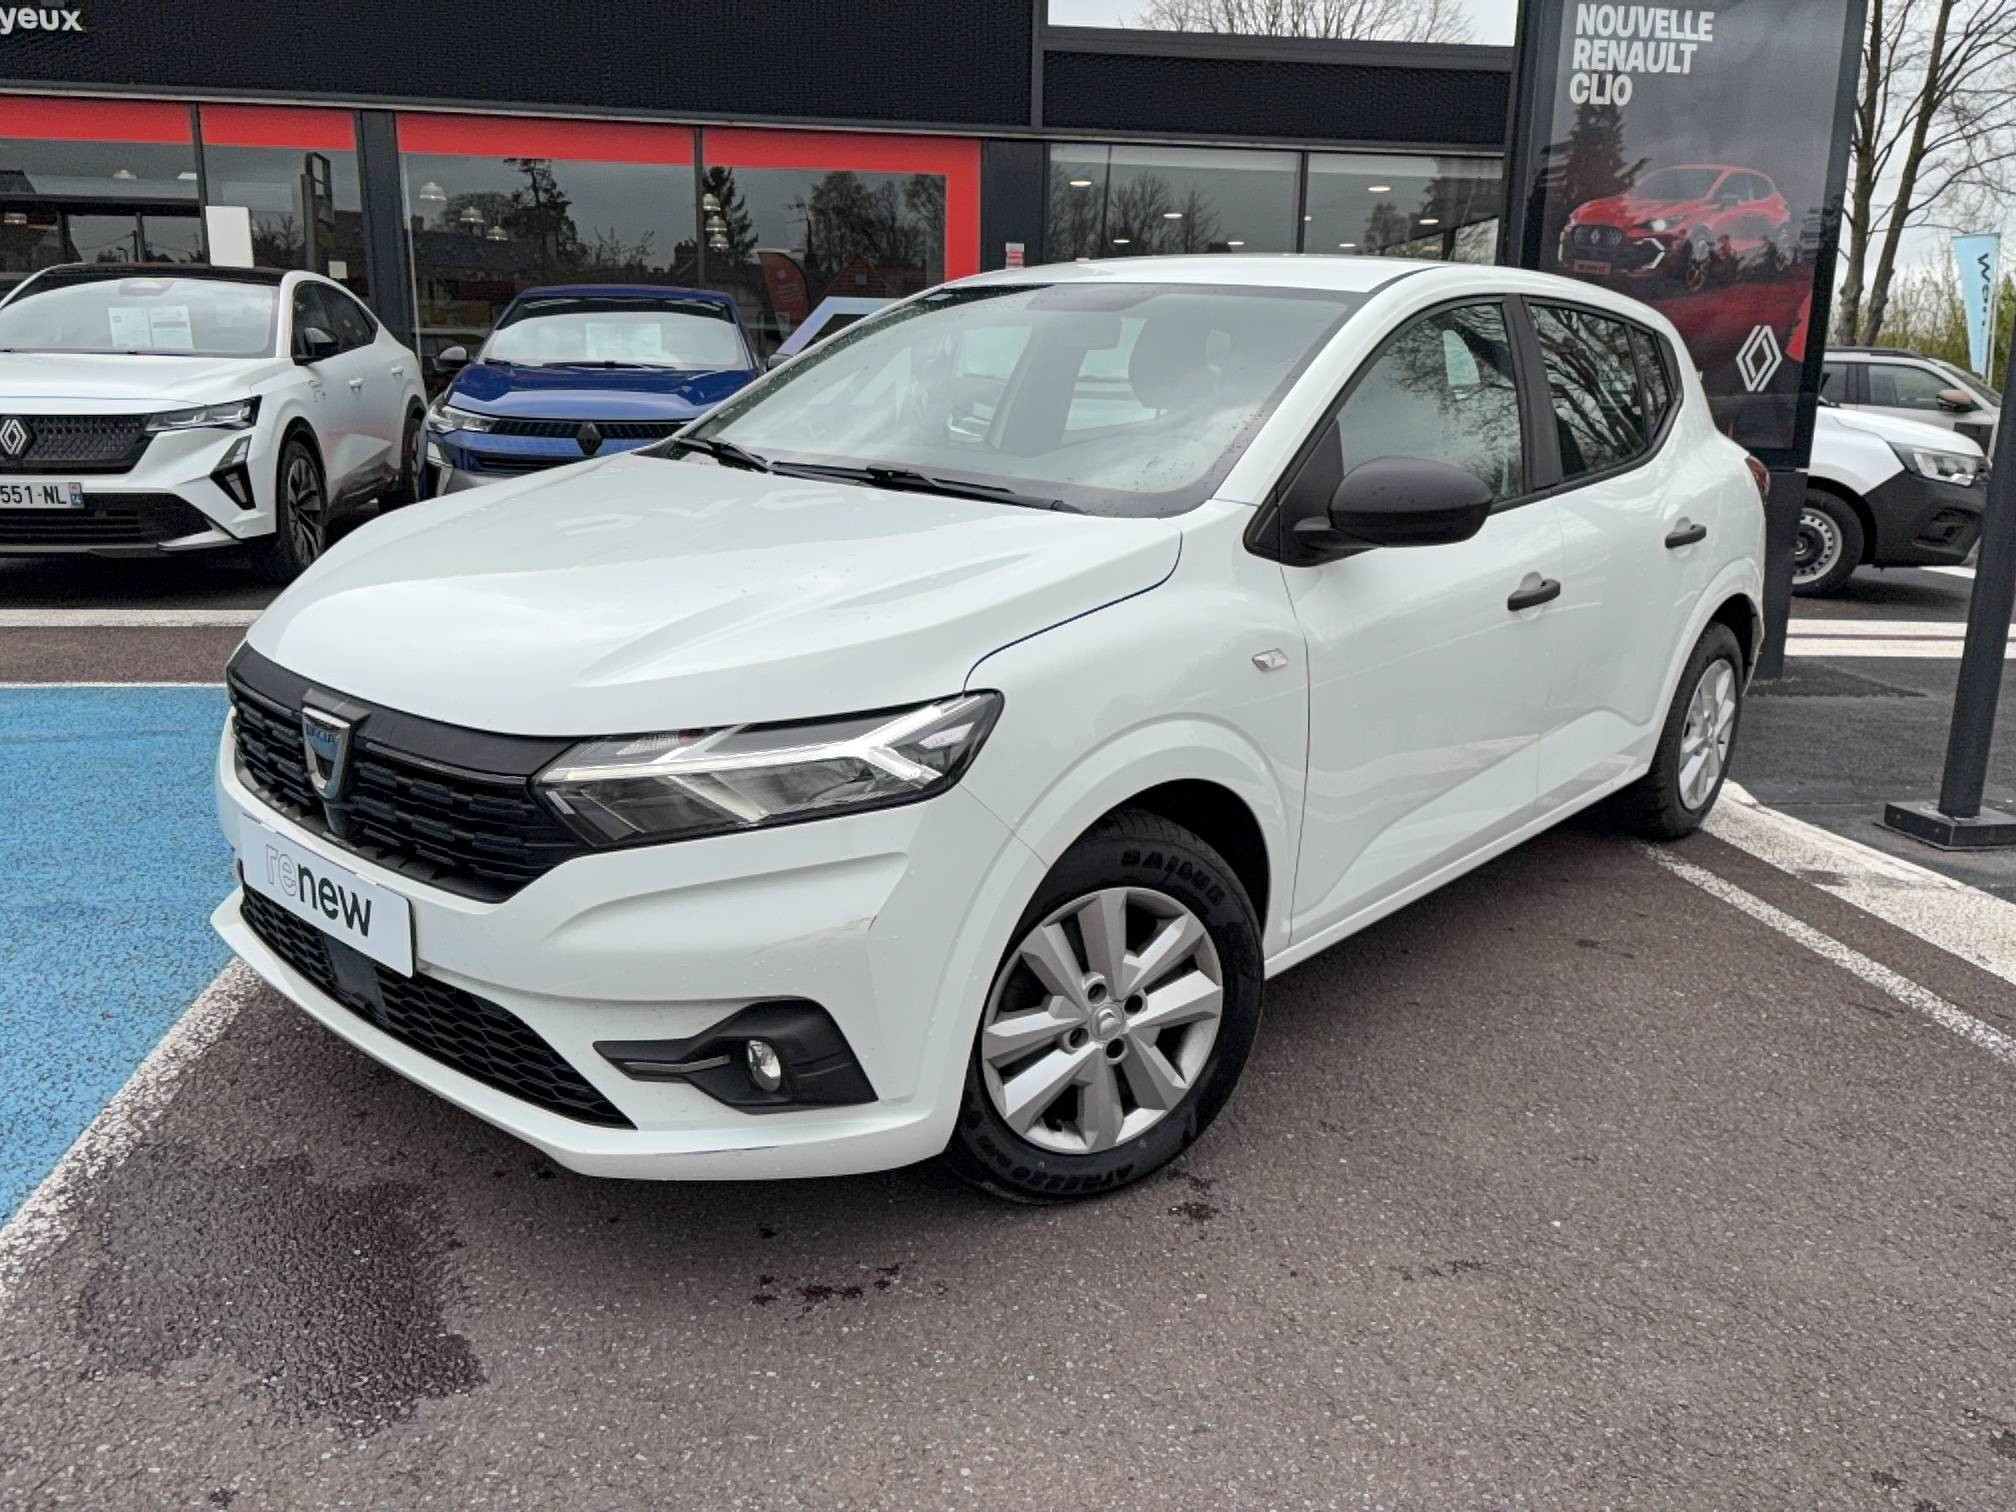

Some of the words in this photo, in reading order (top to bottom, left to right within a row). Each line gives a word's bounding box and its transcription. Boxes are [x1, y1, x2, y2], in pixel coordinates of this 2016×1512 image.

[1575, 3, 1715, 42] NOUVELLE
[1572, 38, 1698, 74] RENAULT
[1569, 72, 1633, 107] CLIO
[265, 843, 372, 938] renew
